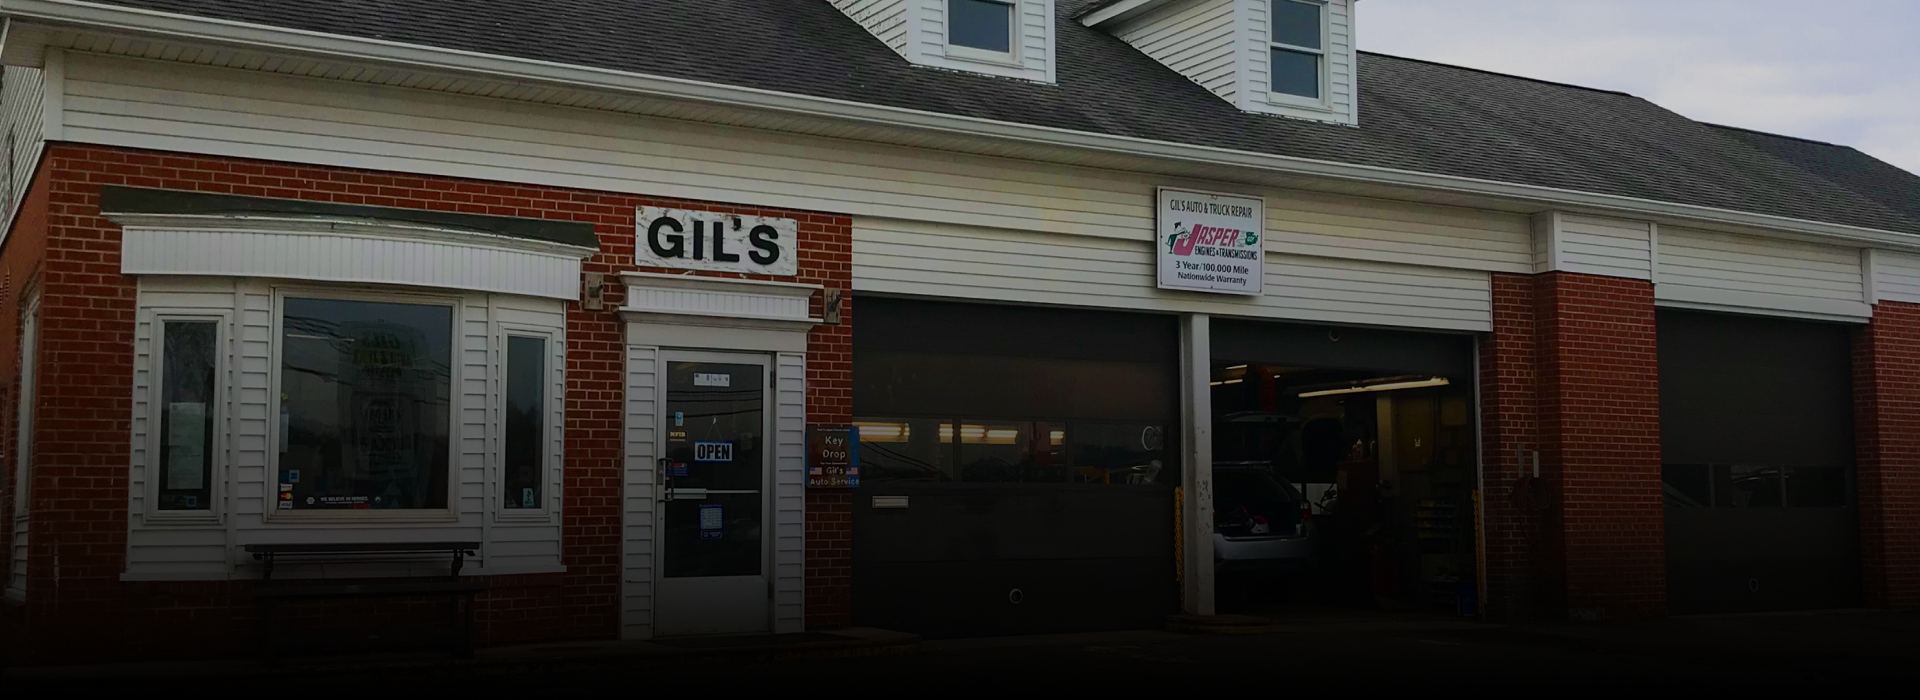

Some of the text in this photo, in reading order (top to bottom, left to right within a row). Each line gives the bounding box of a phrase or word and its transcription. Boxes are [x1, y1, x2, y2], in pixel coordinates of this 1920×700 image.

[1170, 199, 1253, 218] GIL'S AUTO & TRUCK REPAIR
[647, 216, 780, 265] GIL'S
[1173, 223, 1240, 256] JASPER
[1195, 245, 1216, 257] ENGINES
[1219, 247, 1258, 261] TRANSMISSIONS
[1175, 260, 1181, 269] 3
[1233, 265, 1249, 275] Mile
[1178, 271, 1247, 286] Nationwide Warranty
[825, 435, 844, 447] Key
[697, 444, 730, 460] OPEN
[822, 449, 846, 460] Drop
[826, 466, 844, 475] Gil's
[810, 477, 860, 486] Auto Service
